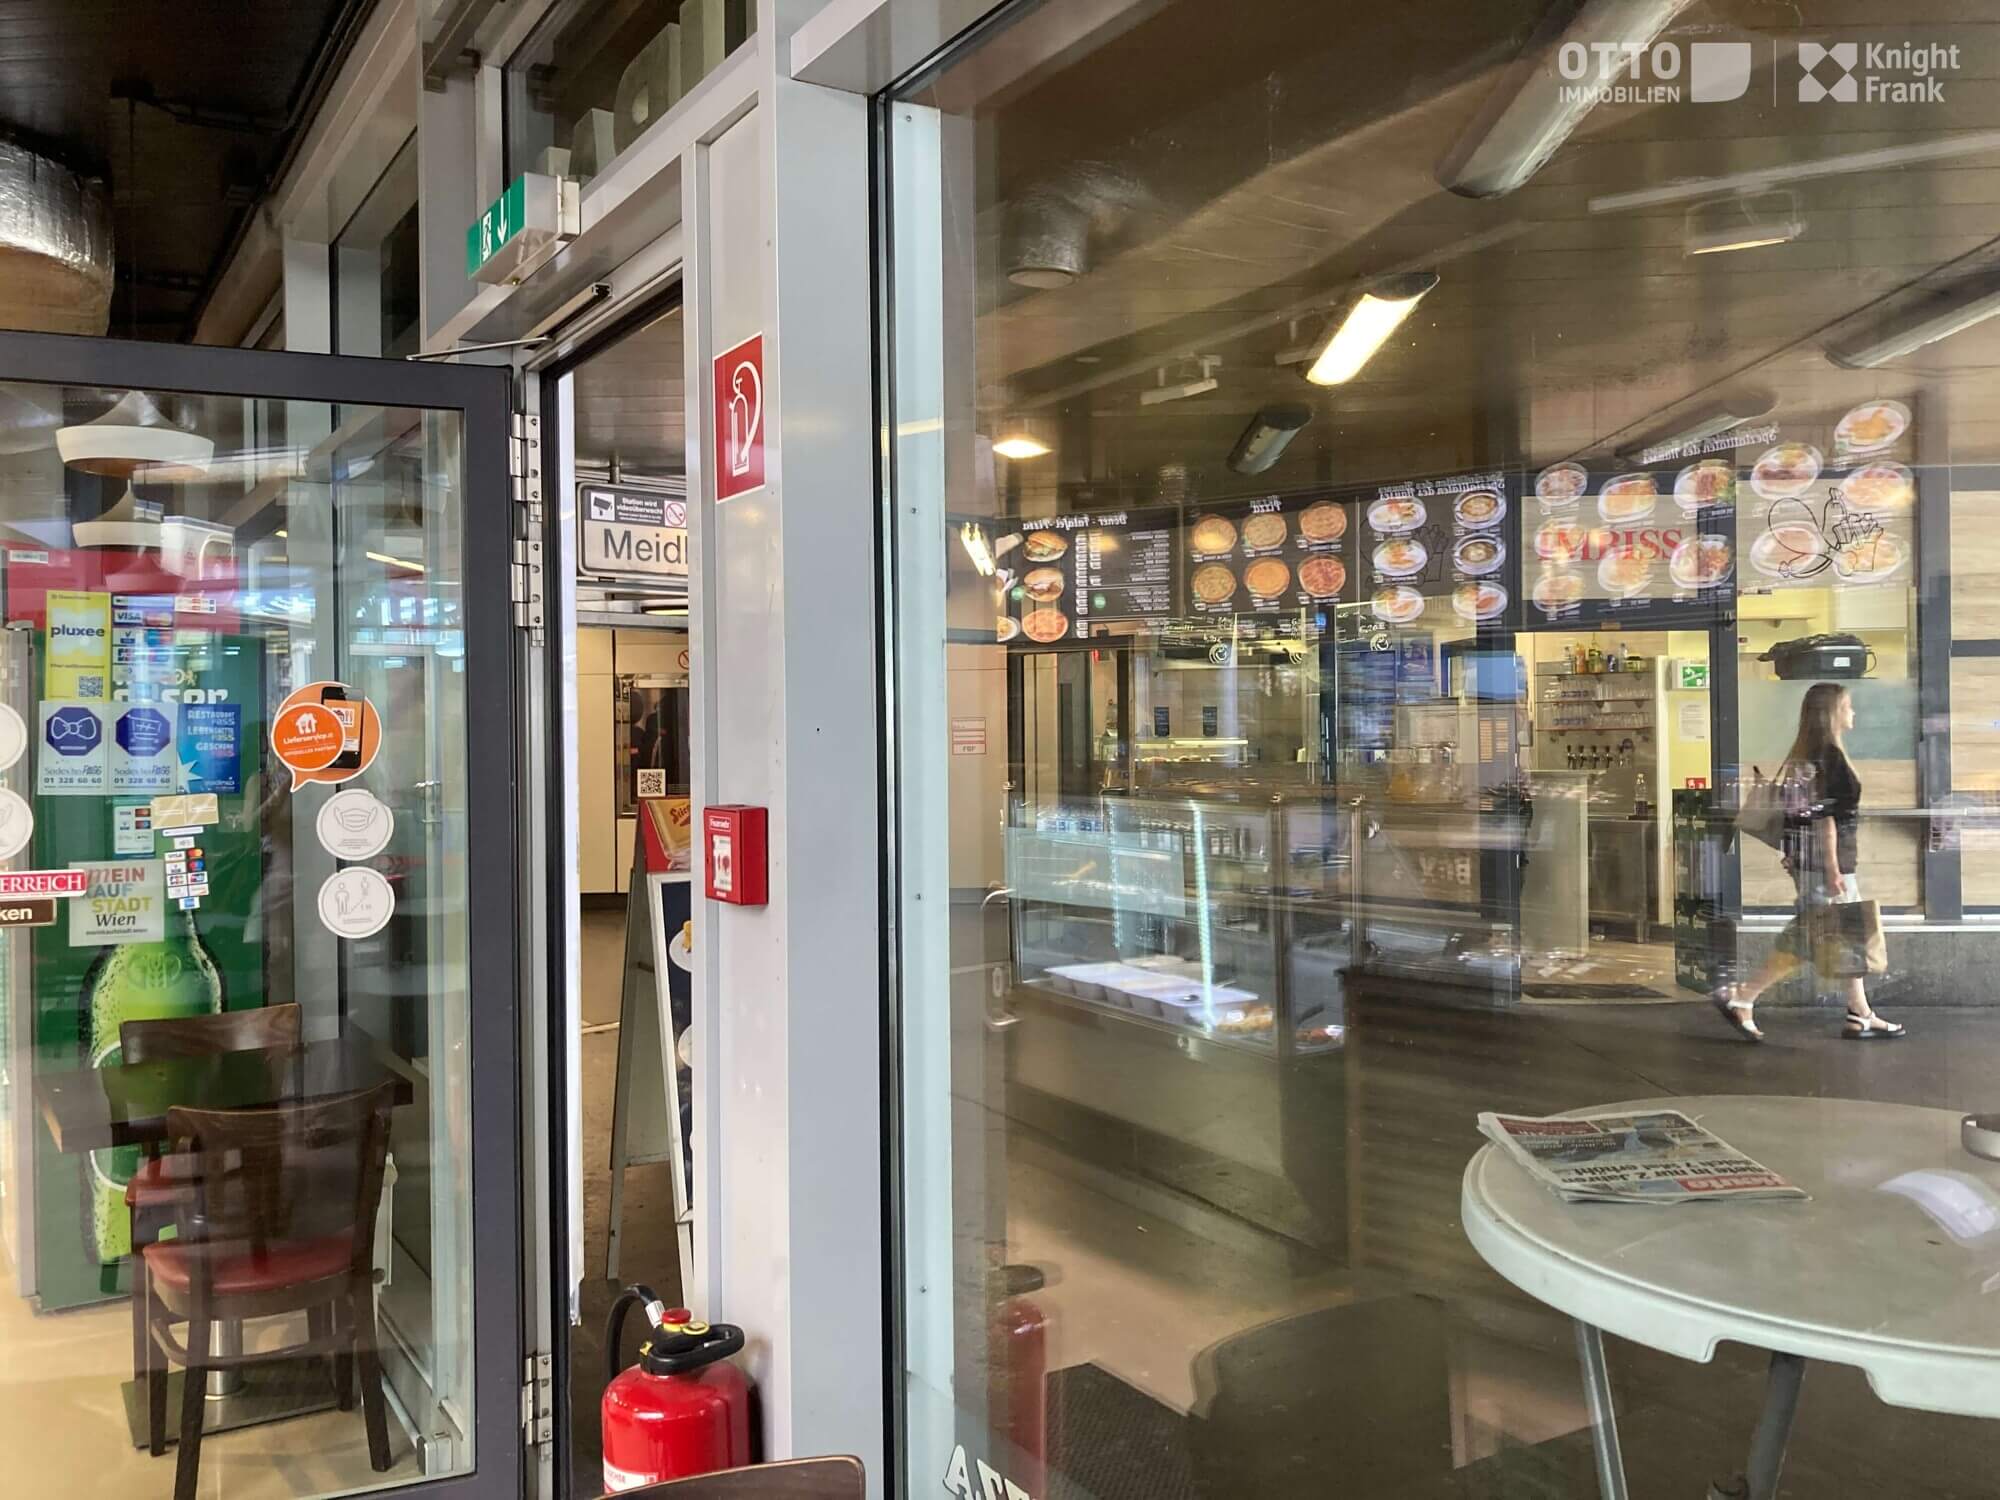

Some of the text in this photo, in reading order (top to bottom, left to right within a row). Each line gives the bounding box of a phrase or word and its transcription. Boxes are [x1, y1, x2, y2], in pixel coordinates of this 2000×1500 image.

[50, 624, 105, 638] pluxee
[92, 897, 152, 913] STADT
[96, 913, 136, 927] Wien
